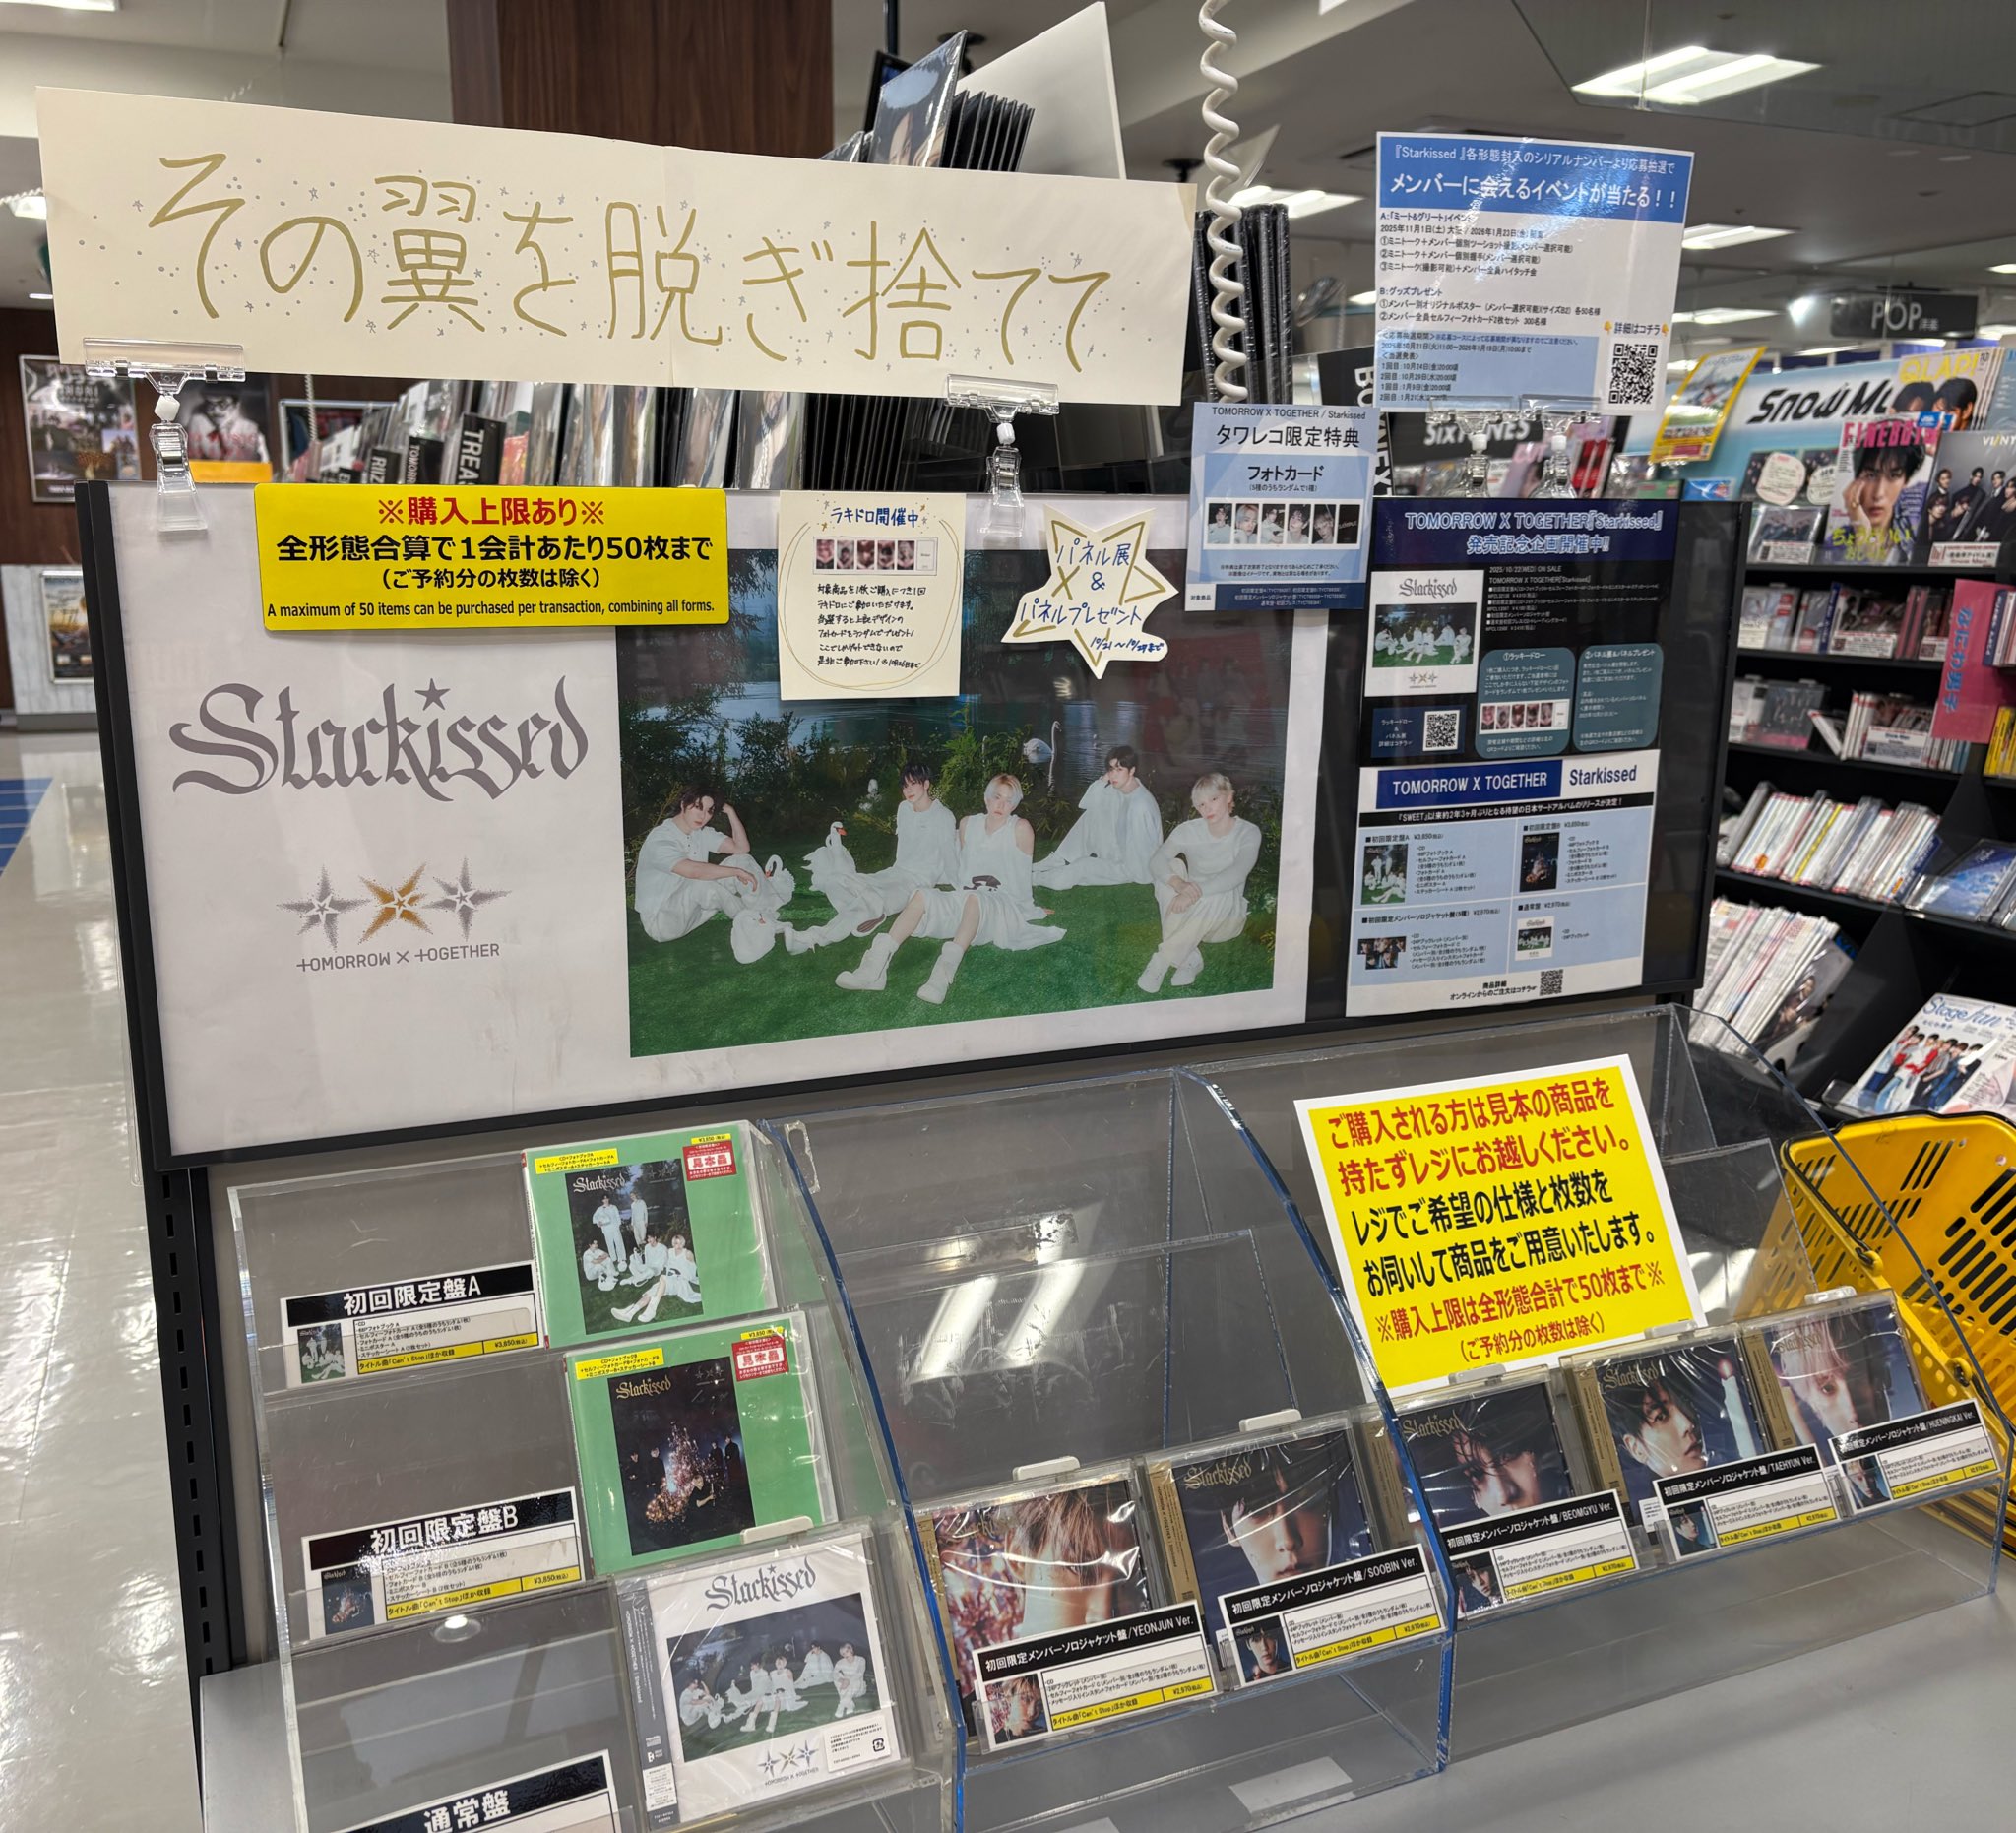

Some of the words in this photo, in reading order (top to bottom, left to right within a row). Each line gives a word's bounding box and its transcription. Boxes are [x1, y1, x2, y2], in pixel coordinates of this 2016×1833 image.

[149, 153, 1111, 372] その翼を脱ぎ捨てて
[1613, 323, 1662, 336] 詳細はコチラ
[1871, 298, 1922, 331] POP
[1212, 407, 1264, 417] TOMORROW
[1275, 409, 1319, 418] TOGETHER
[1328, 410, 1366, 420] Starkissed
[1216, 424, 1360, 448] タワレコ限定特典
[459, 429, 483, 485] TREA
[1247, 465, 1325, 482] フォトカード
[378, 496, 605, 527] ※購入上限あり※
[830, 507, 919, 528] ラキドロ開催中
[1405, 512, 1497, 531] TOMORROW
[1499, 512, 1512, 530] X
[276, 534, 714, 562] 全形態合算で1会計あたり50枚まで
[1056, 537, 1131, 566] パネル展
[382, 567, 600, 590] (ご予約分の枚数は除く)
[1090, 571, 1106, 592] &
[268, 603, 277, 617] A
[280, 603, 341, 618] maximum
[346, 601, 357, 616] of
[359, 603, 375, 617] 50
[378, 601, 410, 617] items
[413, 604, 434, 617] can
[436, 600, 454, 617] be
[456, 600, 515, 621] purchased
[518, 604, 537, 620] per
[539, 600, 605, 618] transaction,
[608, 600, 663, 619] combining
[665, 599, 679, 614] all
[681, 599, 715, 614] forms.
[1020, 597, 1142, 626] パネルプレゼント
[168, 675, 589, 803] Starkissed
[1392, 776, 1469, 796] TOMORROW
[1472, 775, 1481, 791] X
[1484, 772, 1548, 790] TOGETHER
[1568, 764, 1638, 787] Starkissed
[1327, 1076, 1615, 1150] ご購入される方は見本の商品を
[1337, 1125, 1630, 1197] 持たずレジにお越しください。
[1350, 1168, 1614, 1247] レジでご希望の仕様と枚数を
[1362, 1211, 1656, 1298] お伺いして商品をご用意いたします。
[343, 1275, 482, 1316] 初回限定盤A
[1374, 1260, 1666, 1342] ※購入上限は全形態合計で50枚まで※
[1459, 1311, 1606, 1361] (ご予約分の枚数は除く)
[614, 1374, 672, 1400] Starkissed
[1599, 1501, 1614, 1514] Ver.
[369, 1504, 520, 1555] 初回限定盤B
[704, 1556, 817, 1612] Starkissed
[1230, 1561, 1401, 1616] 初回限定メンバーソロジャケット盤/SOOBIN
[1401, 1555, 1419, 1570] Ver.
[984, 1619, 1175, 1674] 初回限定メンバーソロジャケット盤/YEONJUN
[1175, 1613, 1195, 1627] Ver.
[423, 1789, 512, 1833] 通常盤
